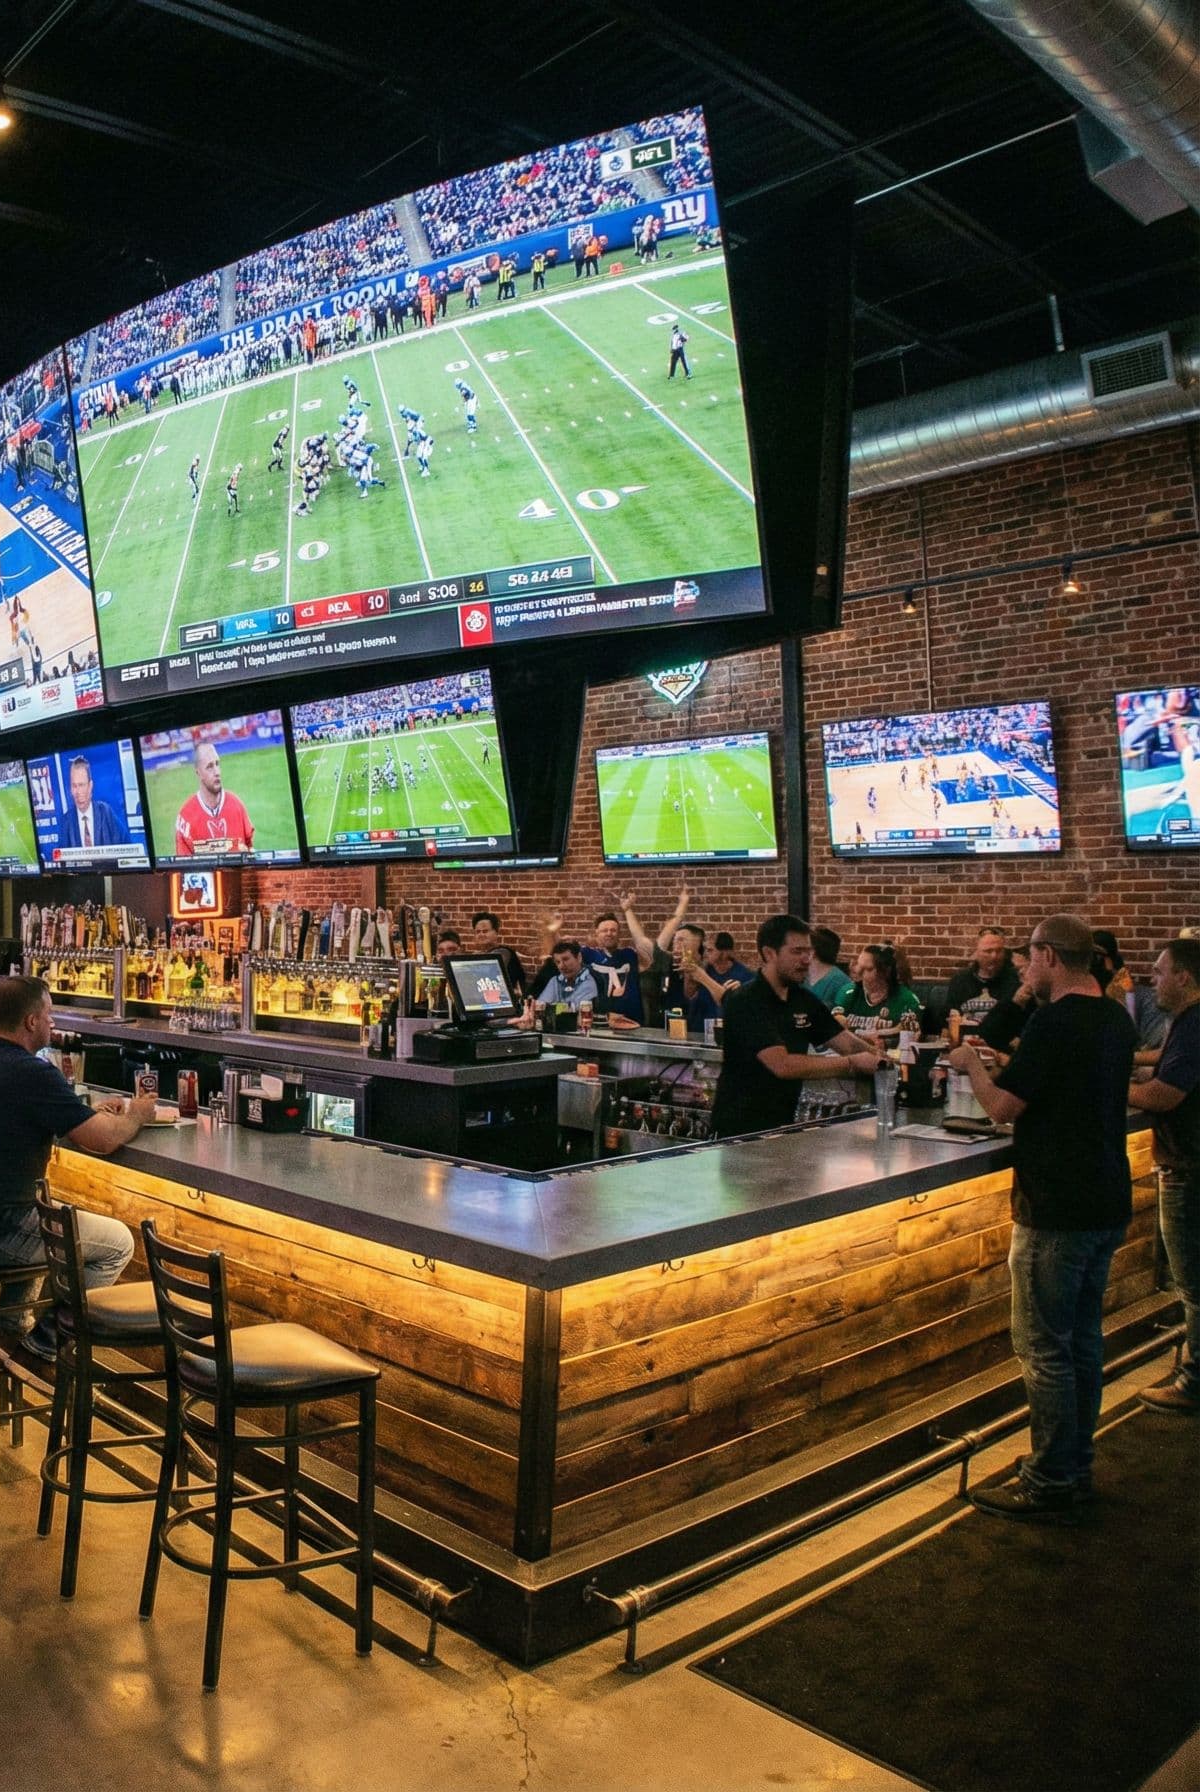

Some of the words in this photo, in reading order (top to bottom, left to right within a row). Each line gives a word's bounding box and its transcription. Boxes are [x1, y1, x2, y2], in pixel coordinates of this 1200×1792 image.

[220, 327, 257, 350] THE
[261, 300, 325, 335] DRAFT
[518, 488, 620, 519] 40
[250, 541, 330, 573] 50
